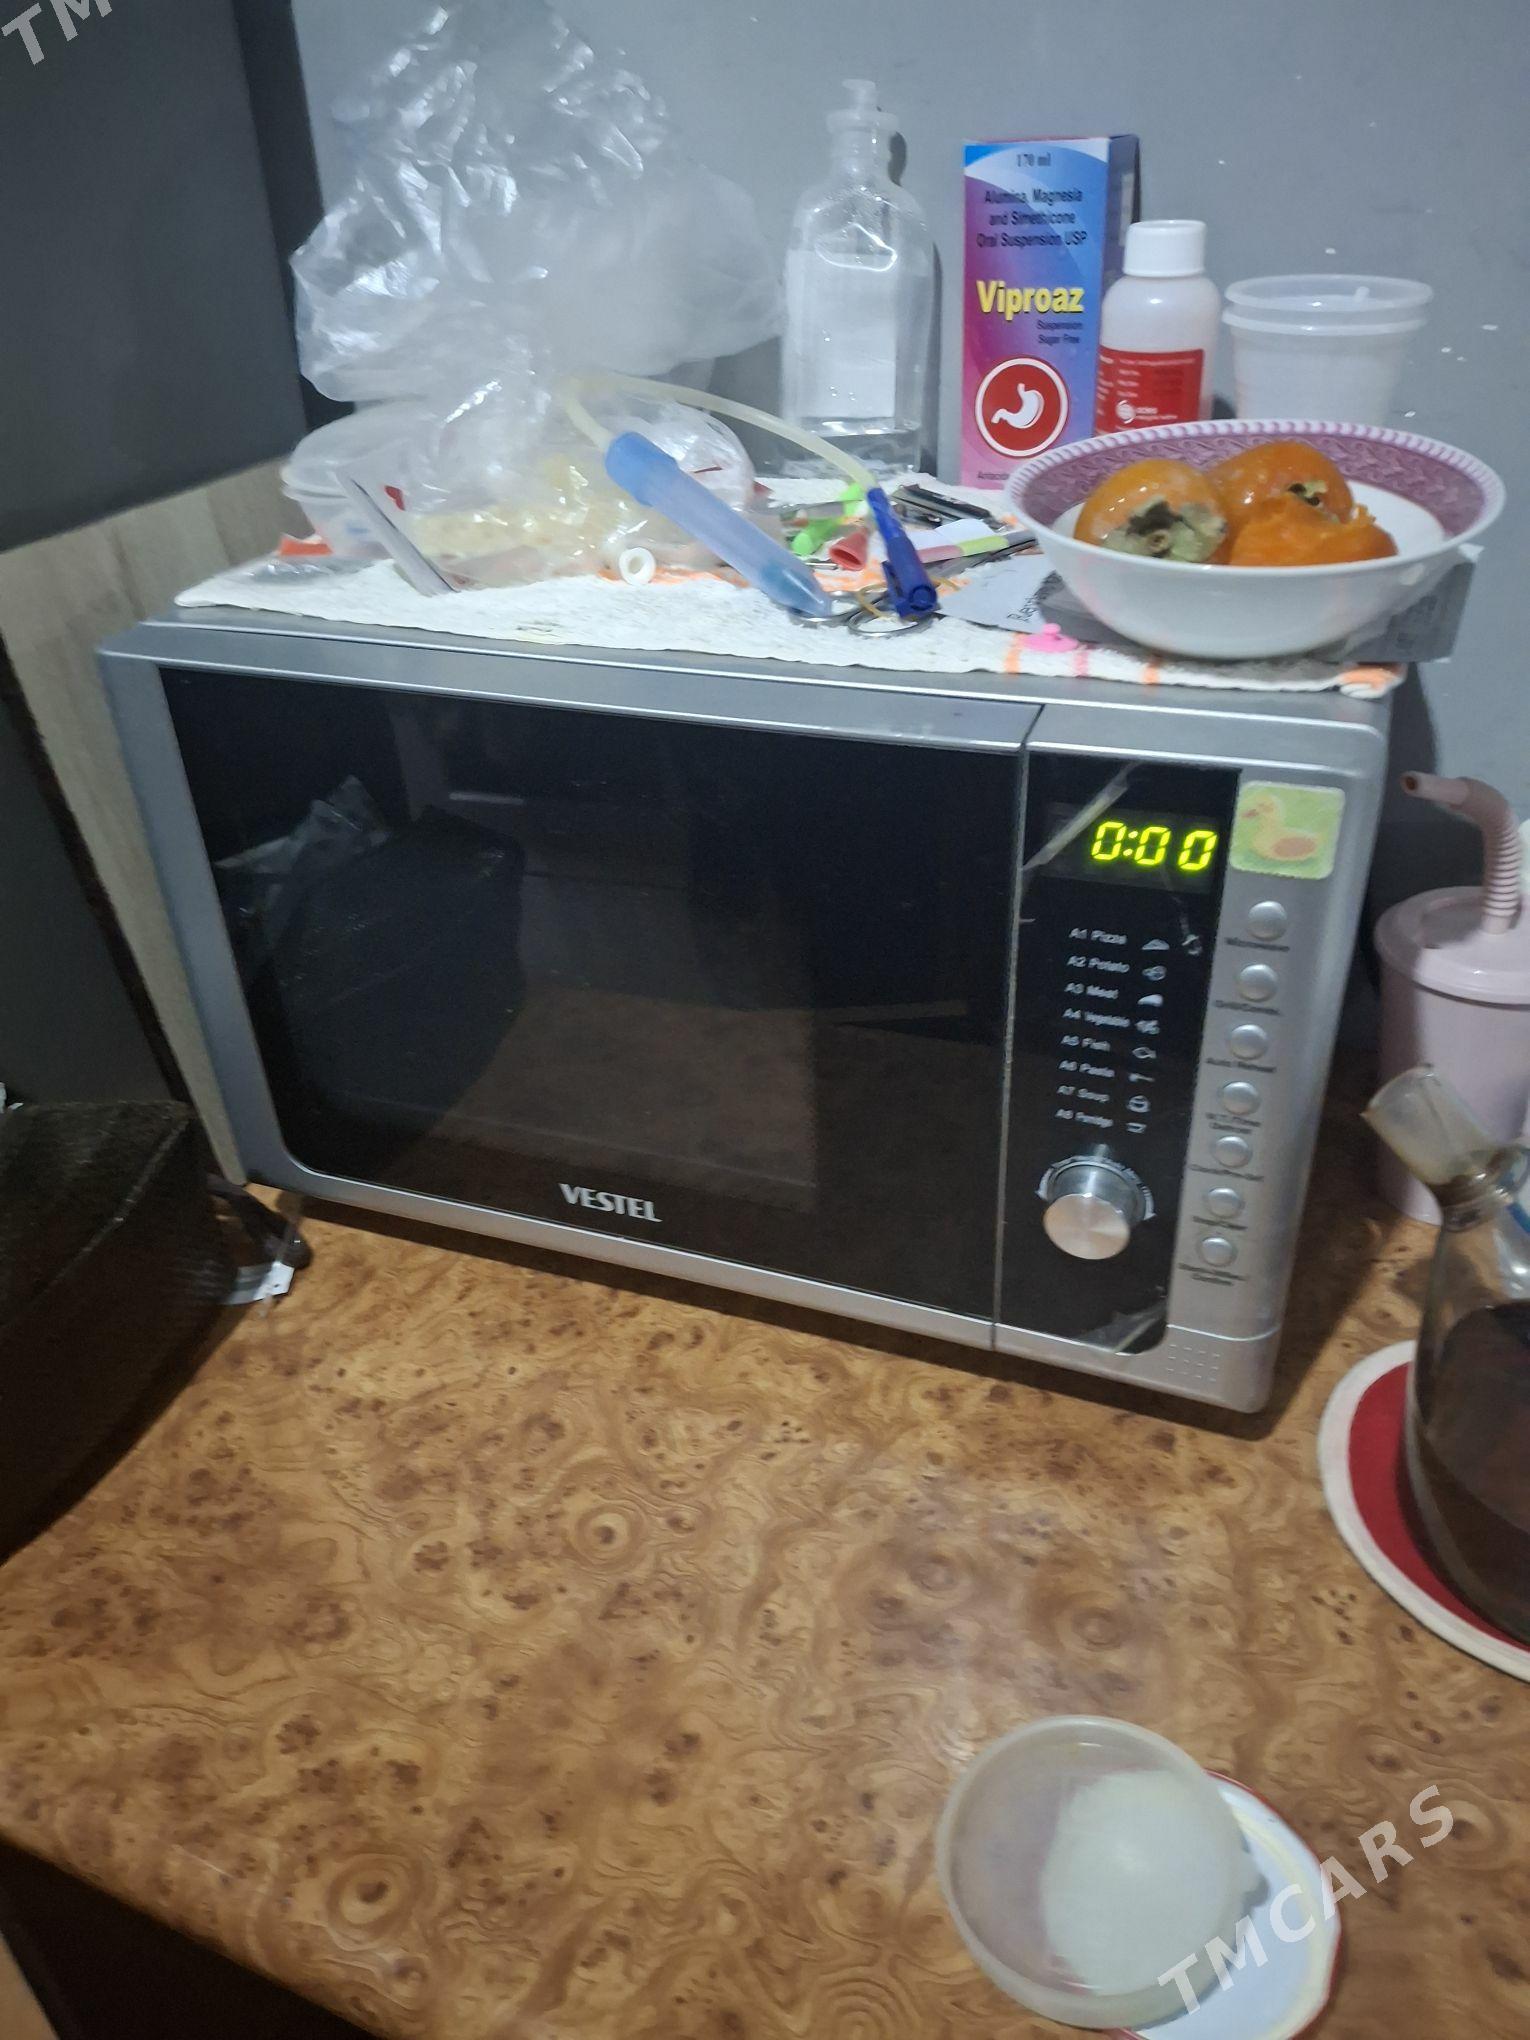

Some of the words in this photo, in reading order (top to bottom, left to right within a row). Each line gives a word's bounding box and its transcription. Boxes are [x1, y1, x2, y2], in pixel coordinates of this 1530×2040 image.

[1036, 152, 1051, 167] ml
[1033, 188, 1083, 206] Magnesia
[989, 210, 1009, 226] and
[1011, 210, 1076, 226] Simethicone
[976, 232, 998, 248] Oral
[1000, 231, 1063, 250] Suspension
[1064, 230, 1088, 246] USP
[975, 279, 1086, 322] Viproaz
[1062, 333, 1081, 344] Free
[1091, 821, 1218, 872] 0:00
[1066, 954, 1087, 969] A2
[1088, 956, 1131, 974] Potato
[558, 1182, 664, 1223] VESTEL
